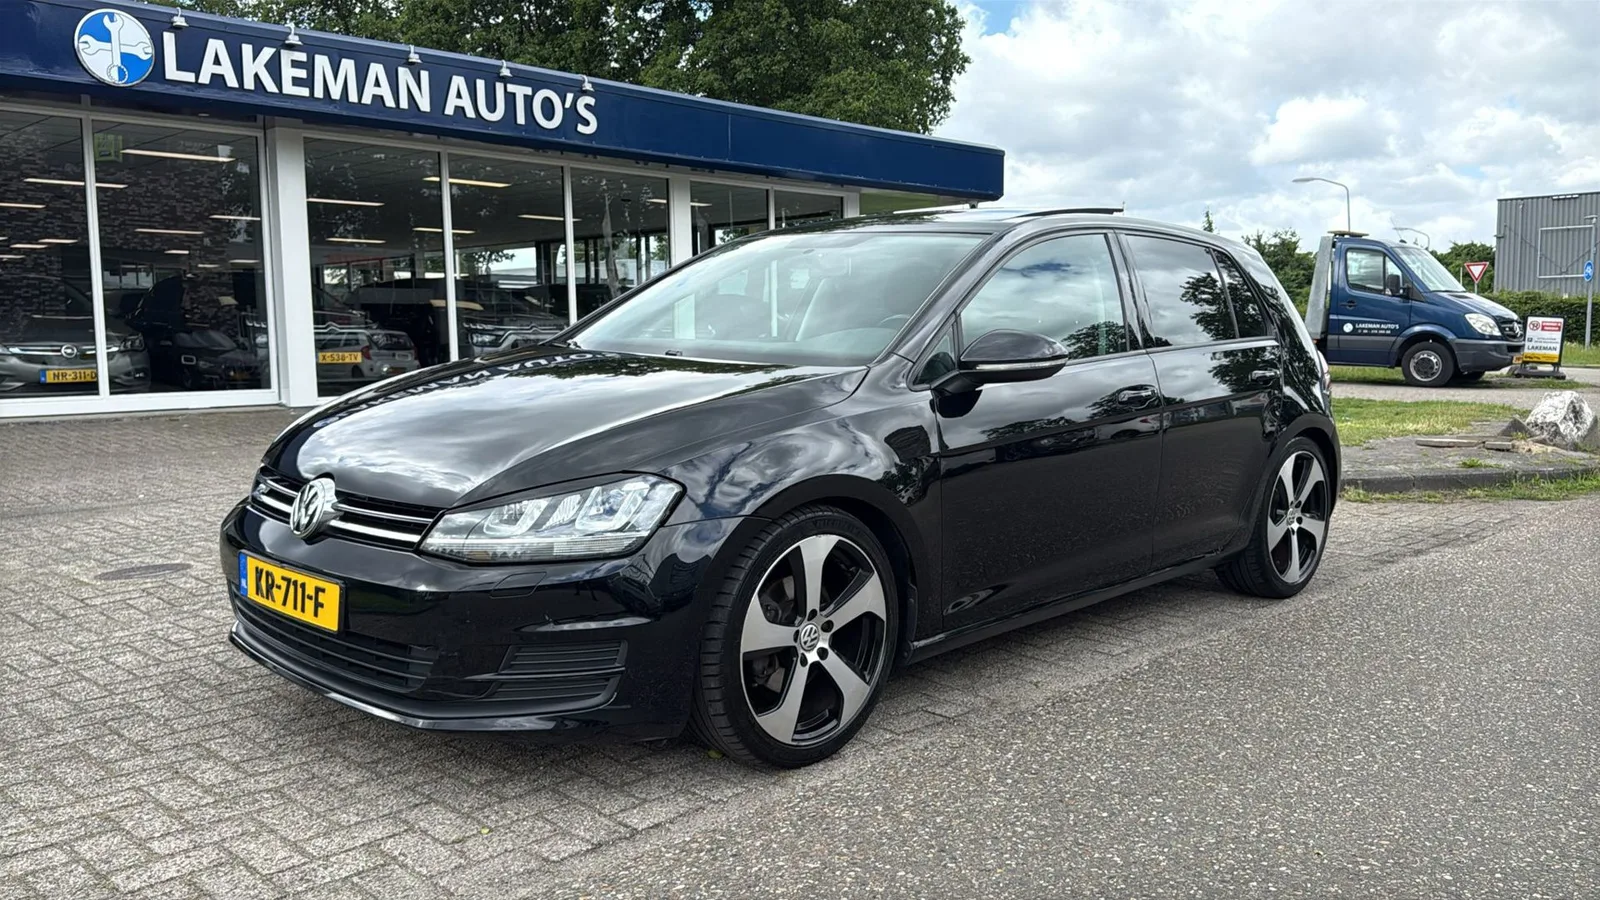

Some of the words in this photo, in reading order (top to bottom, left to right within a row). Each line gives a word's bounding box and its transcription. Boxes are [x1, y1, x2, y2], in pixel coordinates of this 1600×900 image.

[162, 31, 431, 112] LAKEMAN
[444, 75, 598, 135] AUTO'S
[52, 371, 97, 381] NR-311-D
[255, 565, 326, 618] KR-711-F
